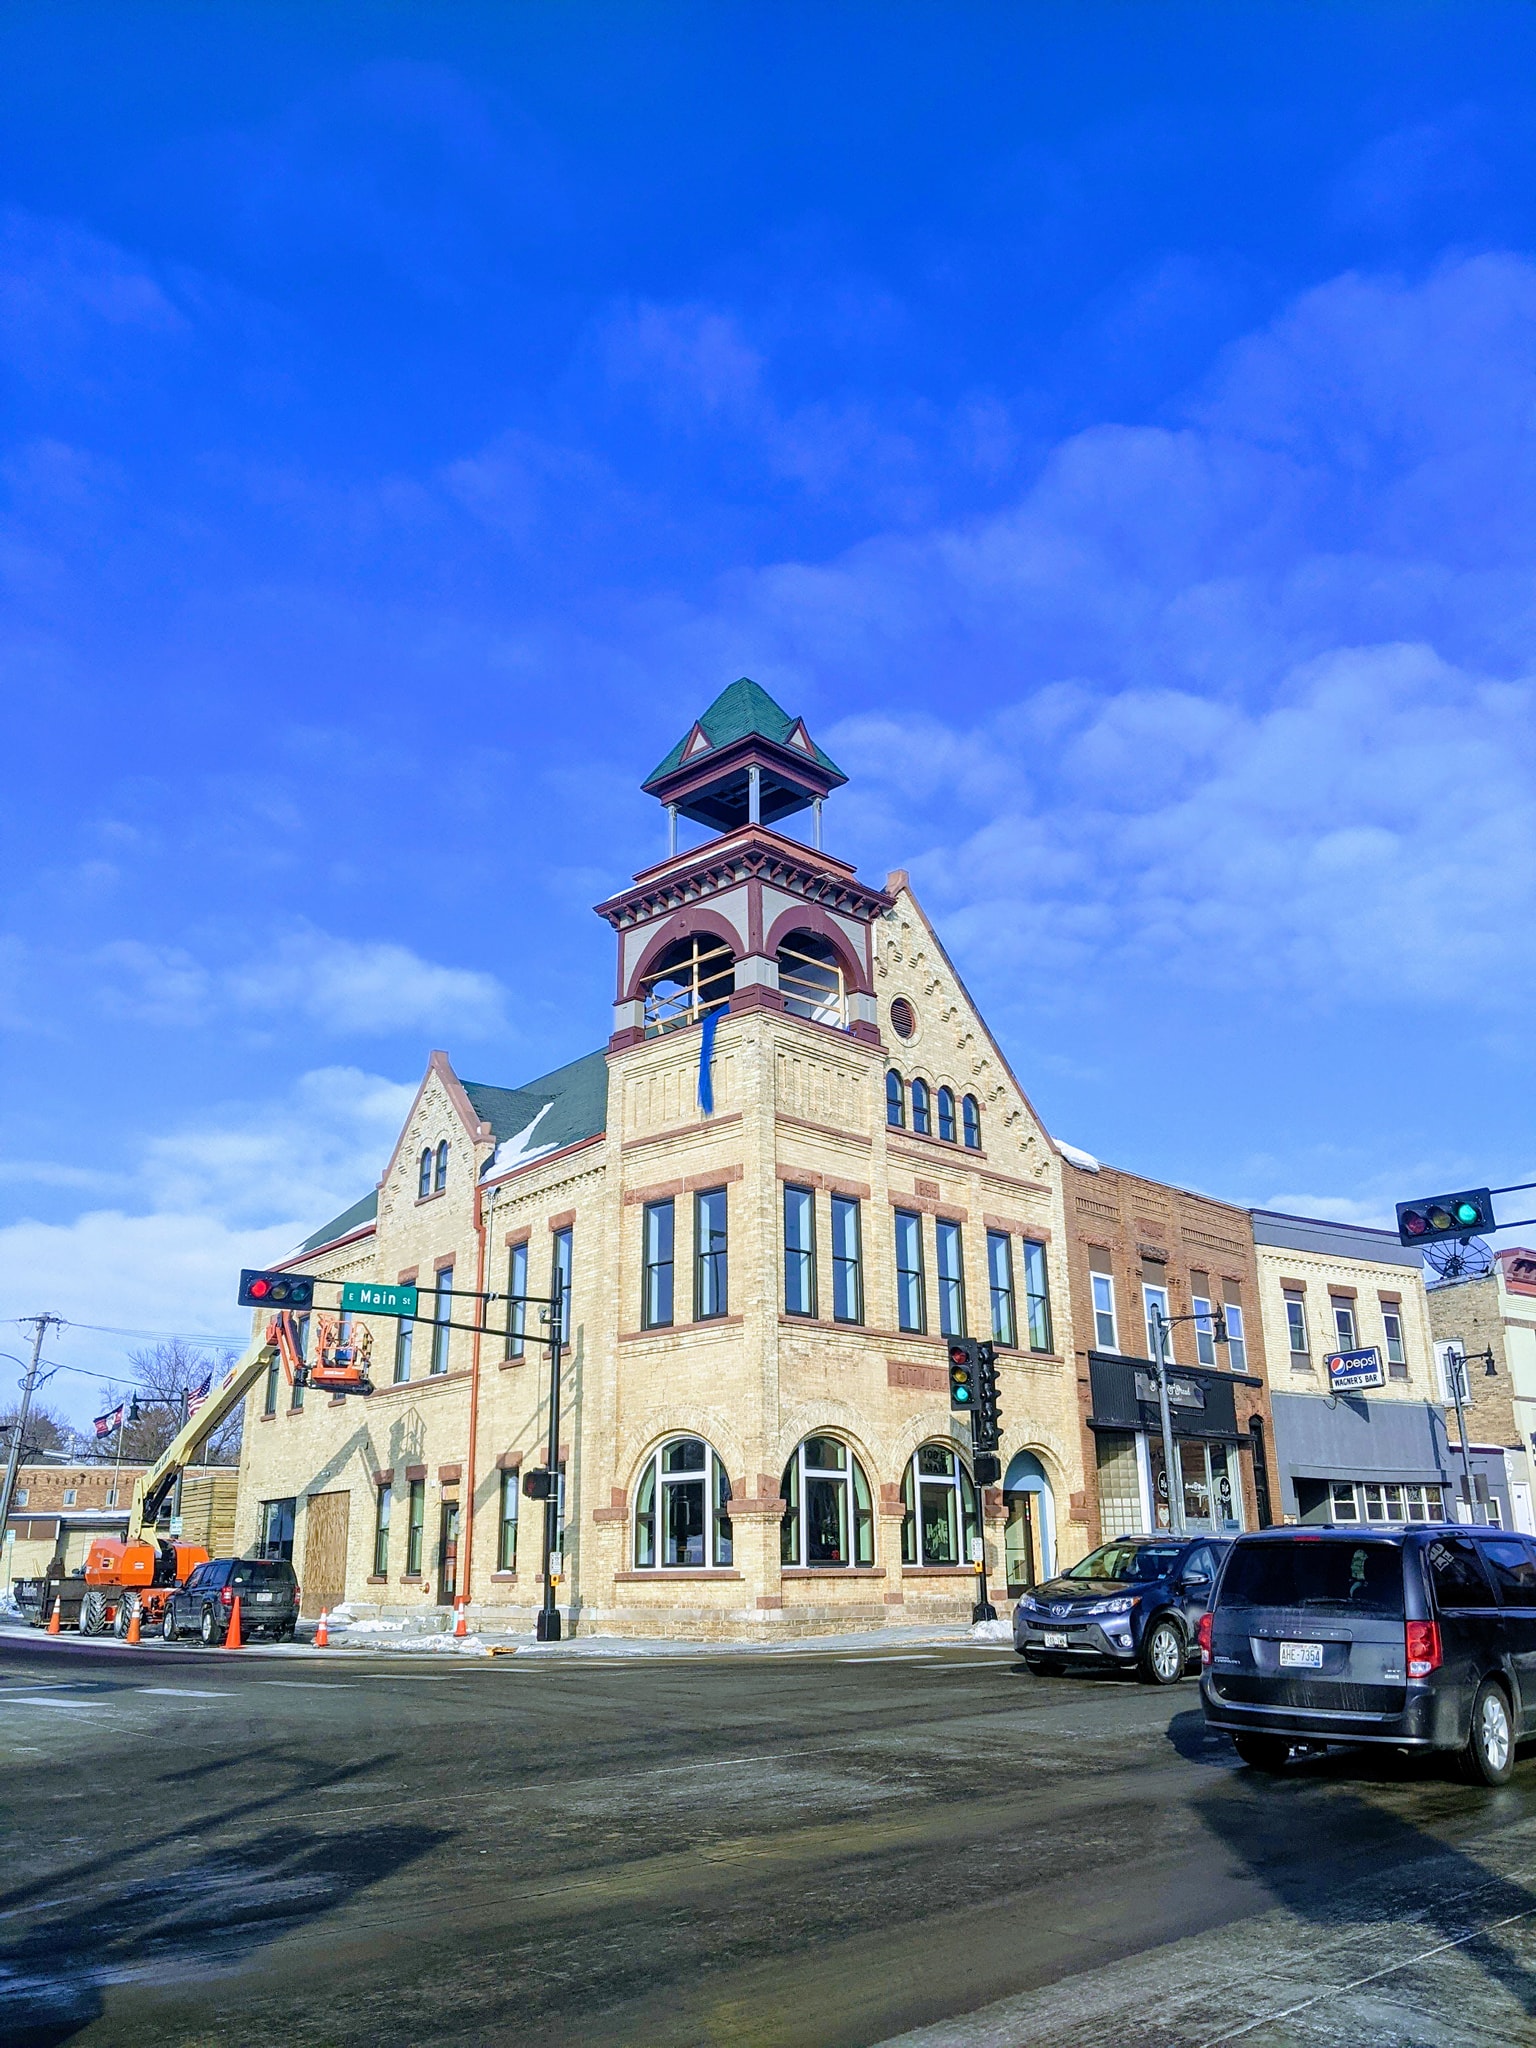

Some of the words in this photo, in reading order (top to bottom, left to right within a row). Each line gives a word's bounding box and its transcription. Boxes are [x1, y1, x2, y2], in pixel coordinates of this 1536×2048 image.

[348, 1292, 354, 1301] E
[360, 1289, 396, 1306] Main
[402, 1296, 411, 1305] St
[1345, 1354, 1376, 1371] pepsi
[1333, 1375, 1363, 1387] WAGNER'S
[1364, 1373, 1378, 1383] BAR
[1282, 1649, 1320, 1662] AHE-7354
